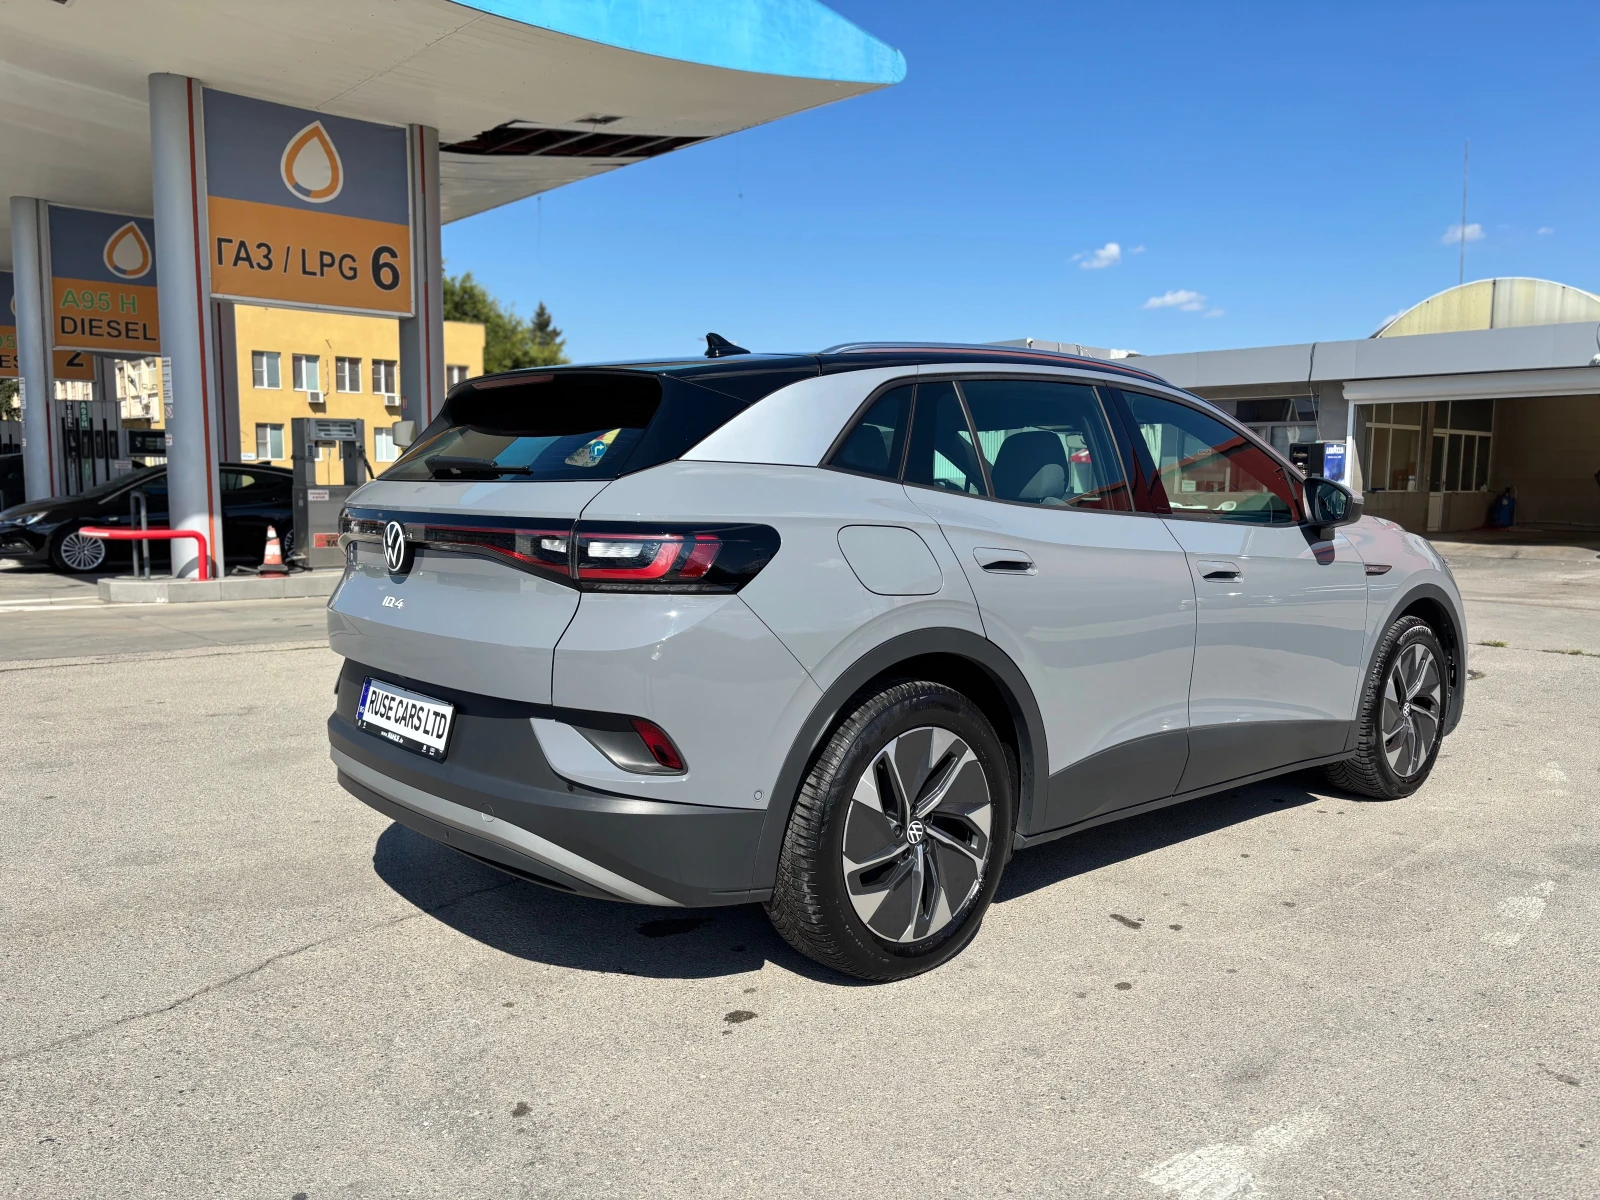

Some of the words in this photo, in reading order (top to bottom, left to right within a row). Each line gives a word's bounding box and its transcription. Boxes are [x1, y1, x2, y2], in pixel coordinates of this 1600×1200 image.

[216, 237, 273, 271] ГАЗ
[301, 248, 358, 281] LPG
[371, 245, 400, 291] 6
[61, 289, 111, 311] A95
[61, 315, 157, 341] DIESEL
[367, 689, 396, 721] RUSE
[394, 699, 425, 732] CARS
[422, 708, 448, 740] LTD
